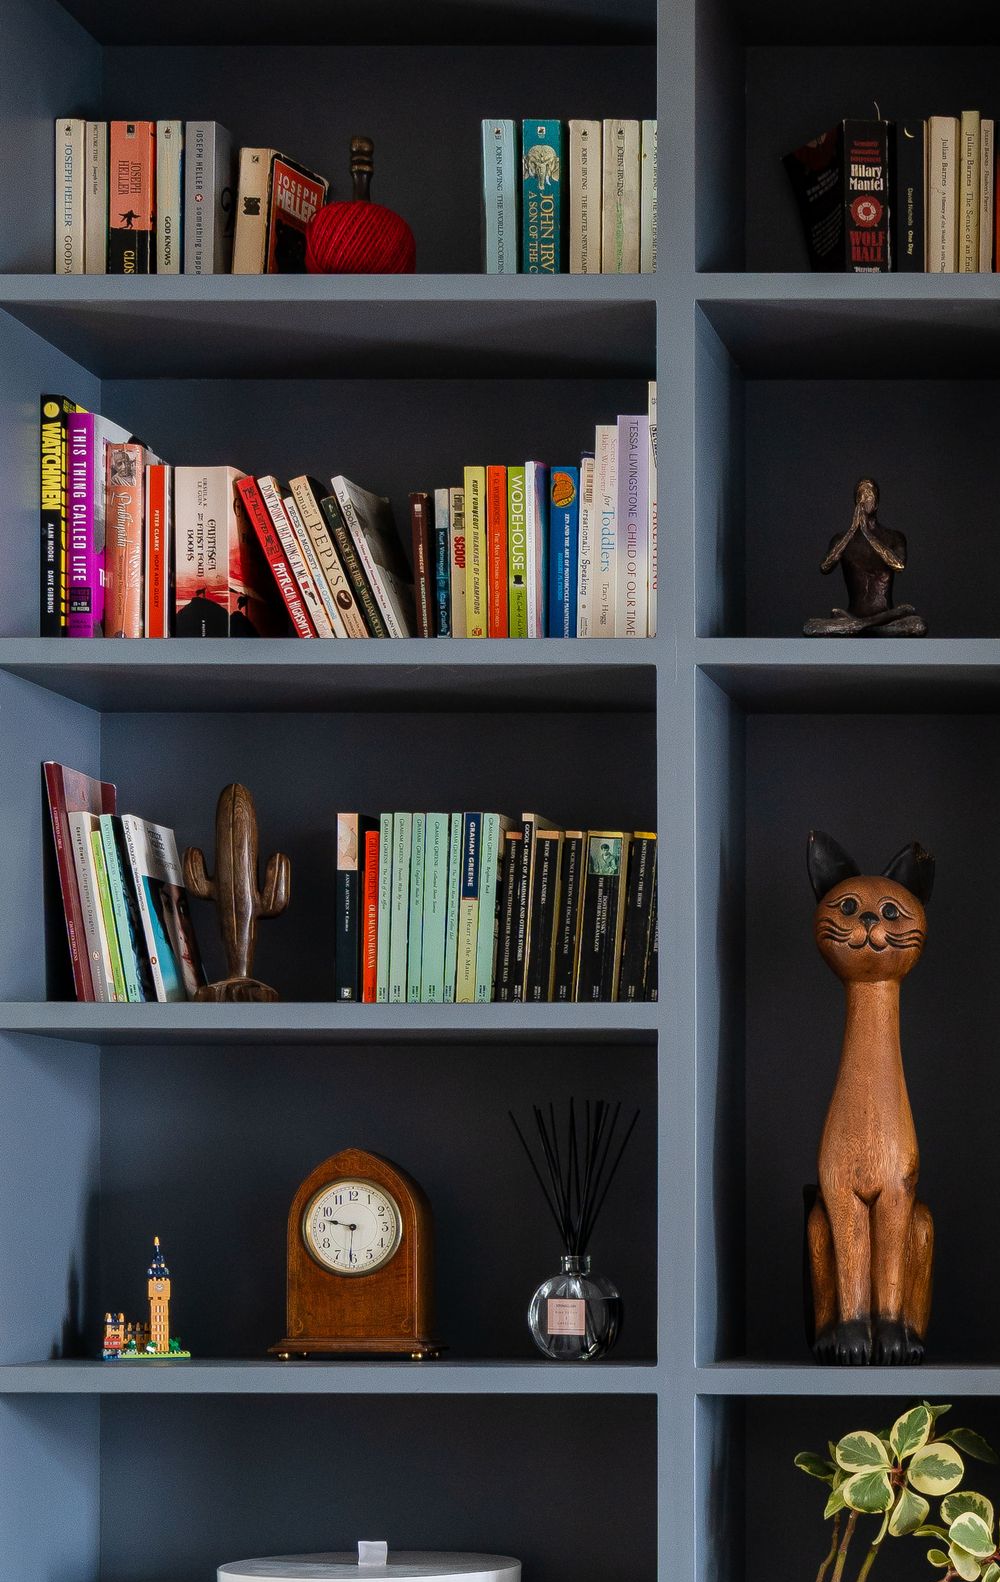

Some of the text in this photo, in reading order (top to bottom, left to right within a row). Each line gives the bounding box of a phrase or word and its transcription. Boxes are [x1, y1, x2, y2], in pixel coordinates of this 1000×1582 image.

[850, 164, 883, 180] Hilary
[195, 129, 203, 248] JOSEPH HELLER something
[849, 177, 884, 191] Mantel
[965, 132, 975, 255] Julian Barnes The Sense of an
[539, 194, 553, 239] JOHN
[529, 191, 537, 263] A SON OF THE
[72, 427, 87, 581] THIS THING CALLED LIFE
[337, 490, 357, 528] The Book
[41, 422, 62, 613] WATCHMEN ALAN MOORE DAVE GIBBONS
[510, 474, 524, 570] WODEHOUSE
[293, 484, 343, 587] Samuel PEPYS
[626, 420, 639, 636] TESSA LIVINGSTONE CHILD OF OUR TIME
[600, 506, 616, 573] Toddlers
[454, 536, 466, 569] SCOOP
[468, 821, 476, 855] GRAHAM
[467, 857, 475, 887] GREENE
[466, 904, 474, 916] The
[465, 918, 473, 936] Heart
[465, 938, 473, 946] of
[334, 1195, 343, 1205] 11
[348, 1190, 359, 1201] 12
[367, 1194, 371, 1205] 1
[323, 1206, 333, 1217] 10
[377, 1206, 385, 1217] 2
[318, 1222, 326, 1232] 9
[381, 1221, 389, 1232] 3
[322, 1237, 331, 1248] 8
[377, 1237, 385, 1248] 4
[334, 1249, 341, 1260] 7
[349, 1253, 358, 1264] 6
[365, 1249, 373, 1259] 5
